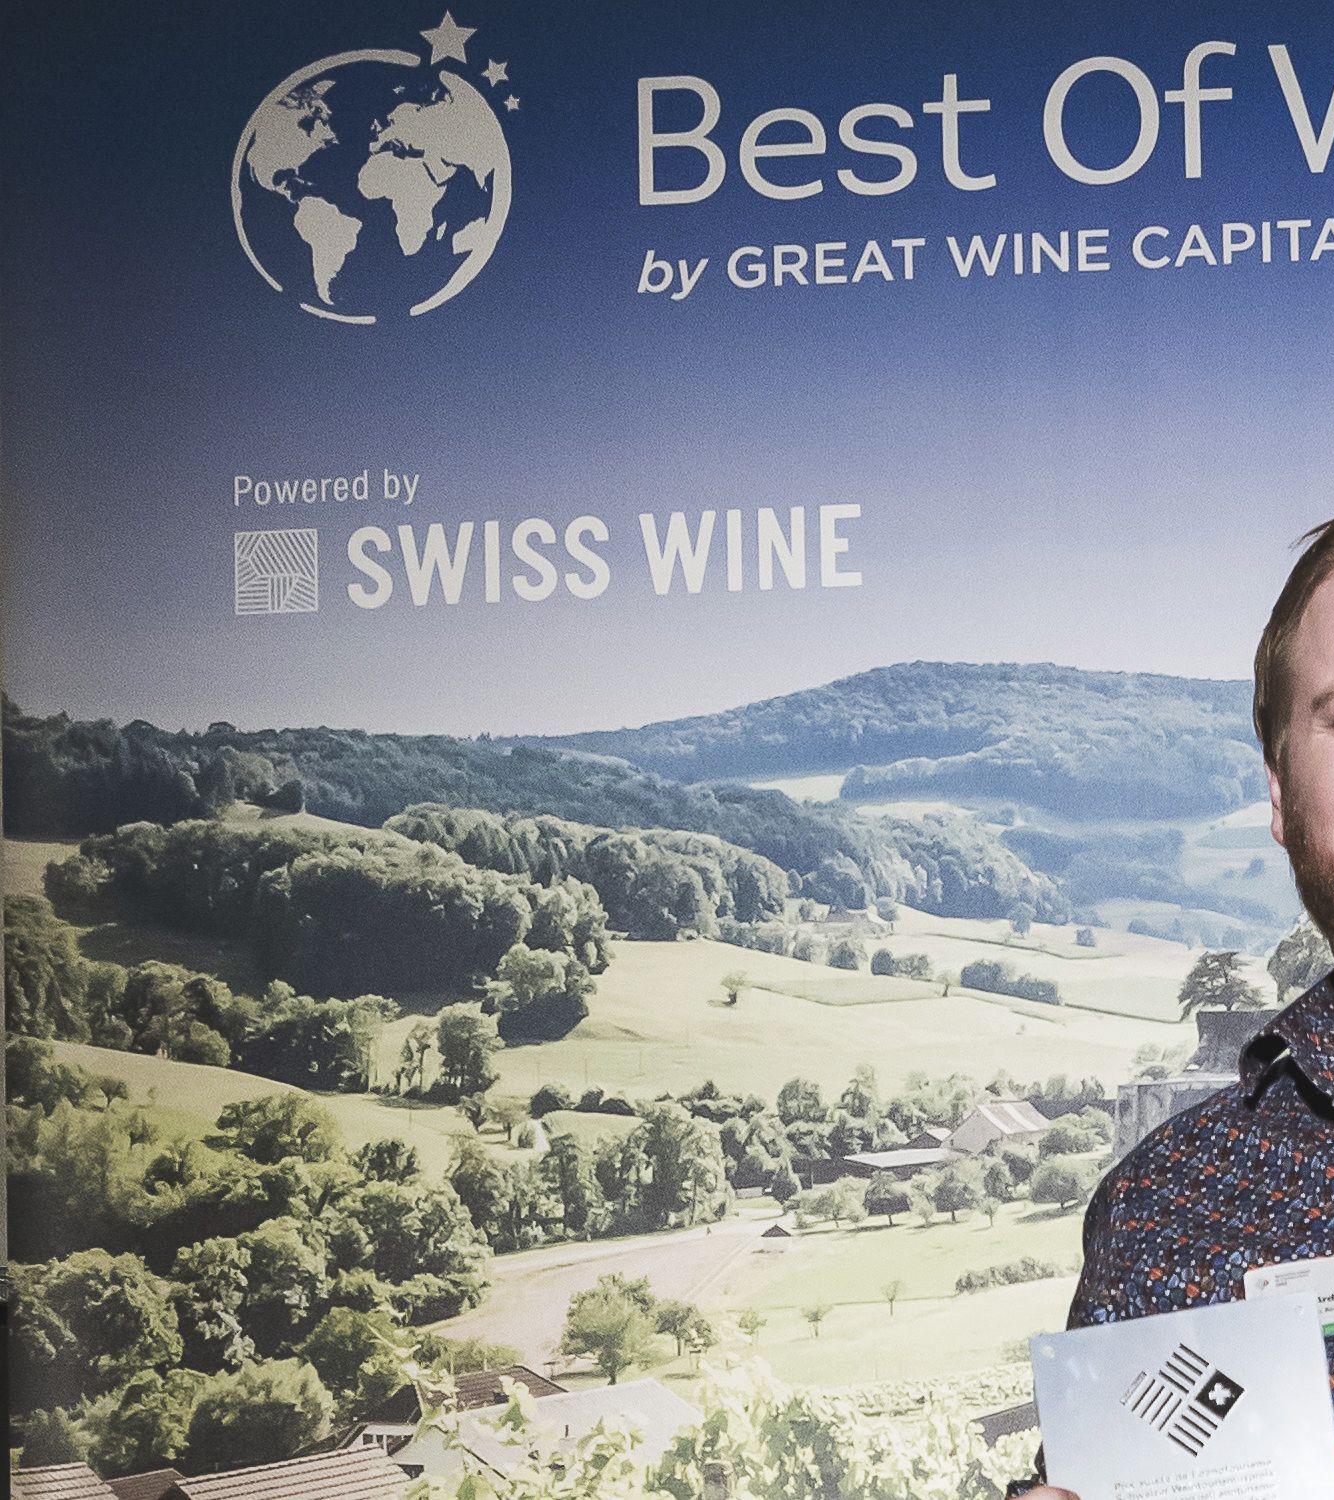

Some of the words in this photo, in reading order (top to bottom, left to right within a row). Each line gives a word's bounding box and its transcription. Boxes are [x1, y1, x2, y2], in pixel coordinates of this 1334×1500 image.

[637, 74, 997, 206] Best
[1043, 41, 1237, 185] Of
[636, 248, 709, 301] by
[727, 237, 926, 290] GREAT
[946, 228, 1111, 279] WINE
[233, 470, 369, 507] Powered
[382, 468, 420, 505] by
[346, 515, 611, 610] SWISS
[638, 503, 864, 596] WINE
